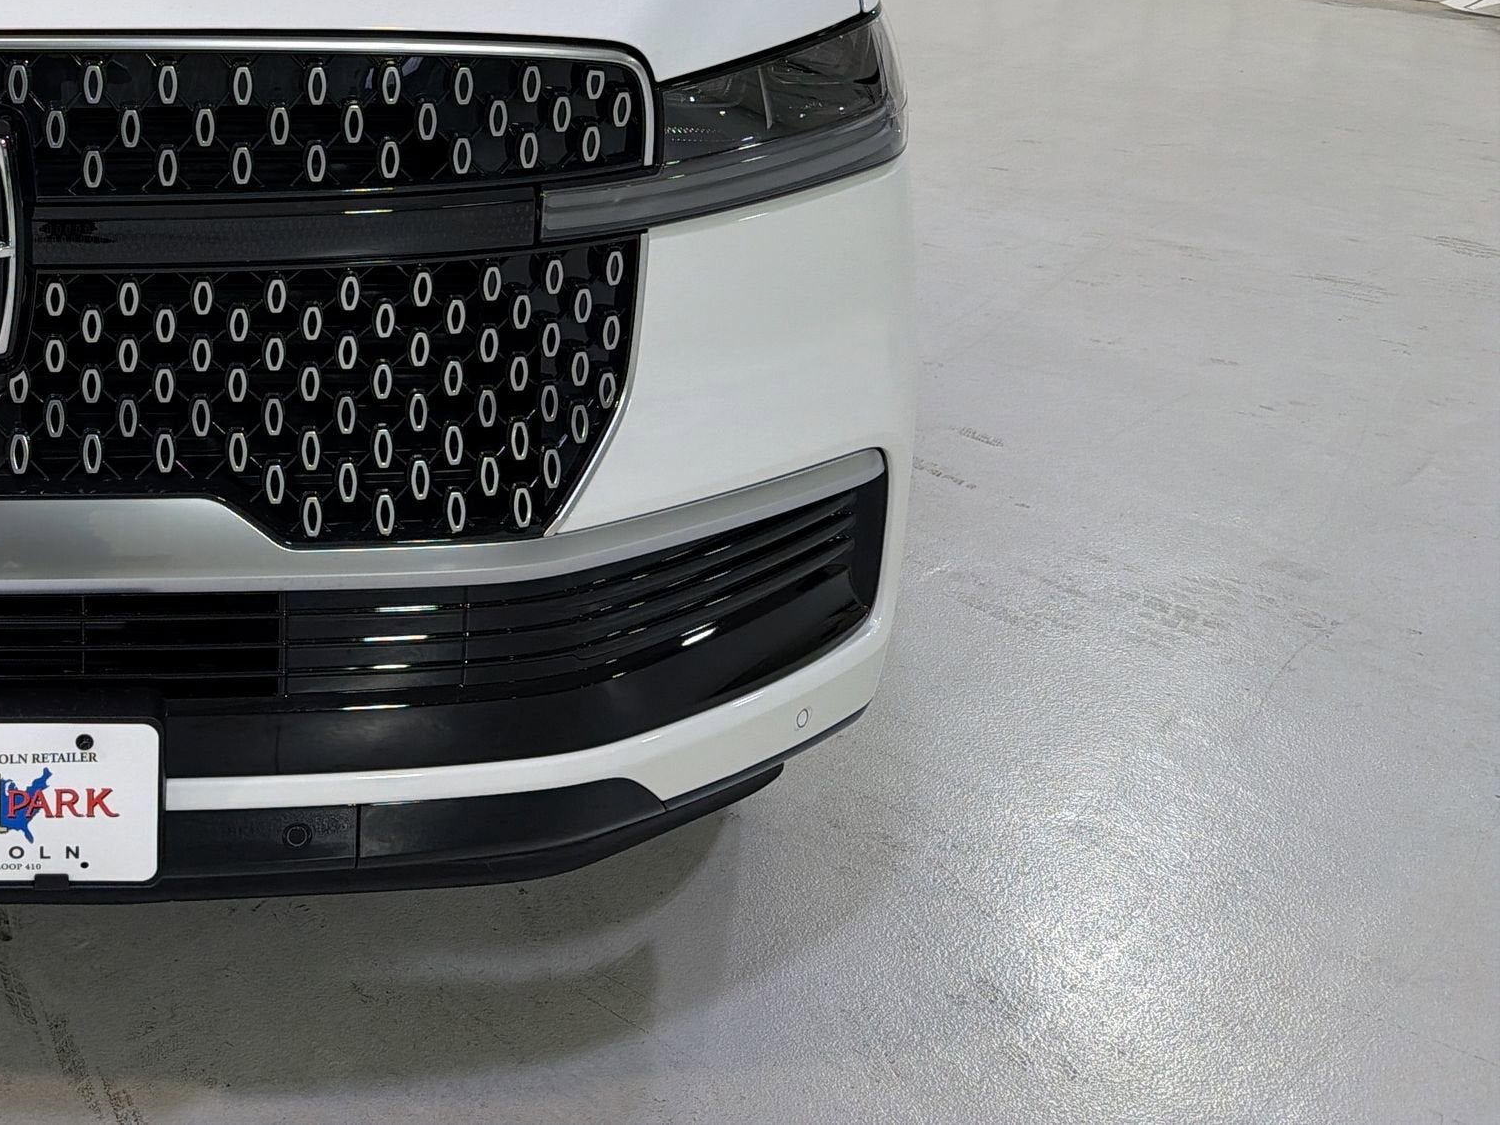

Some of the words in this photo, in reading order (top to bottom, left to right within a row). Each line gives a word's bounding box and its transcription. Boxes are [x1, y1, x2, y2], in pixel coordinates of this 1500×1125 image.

[32, 752, 98, 764] RETAILER
[7, 787, 121, 819] PARK
[25, 862, 41, 871] 410
